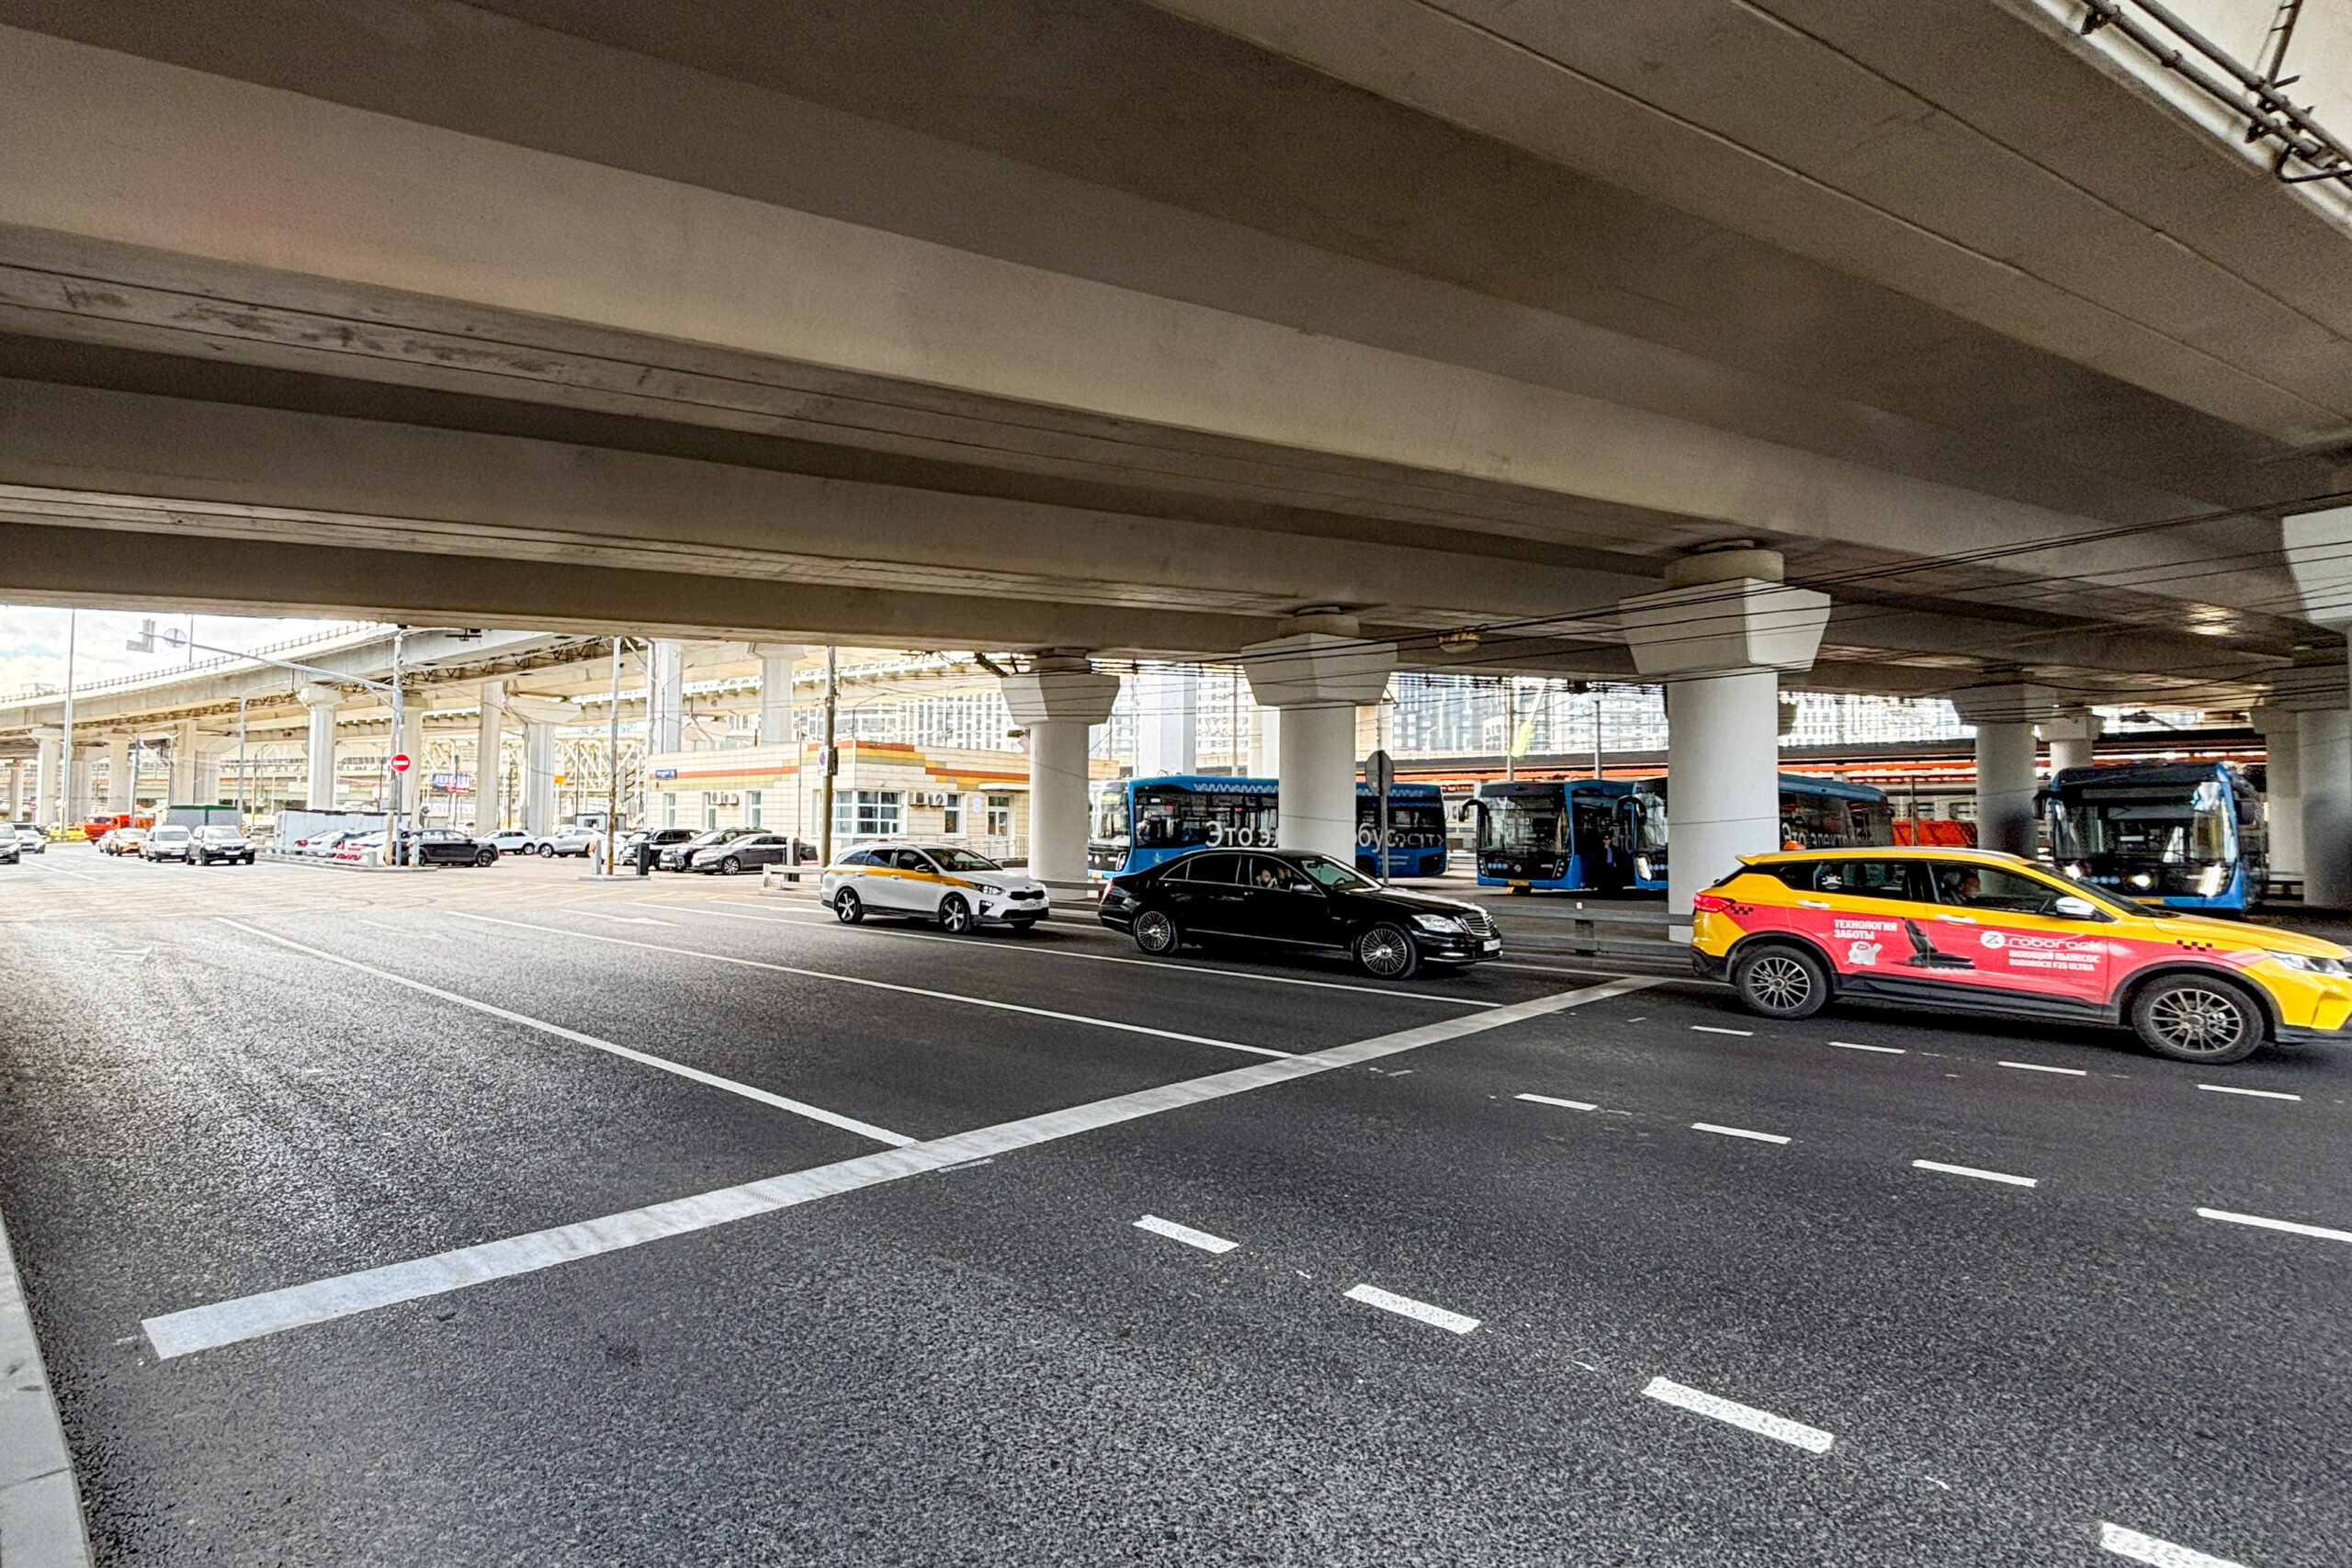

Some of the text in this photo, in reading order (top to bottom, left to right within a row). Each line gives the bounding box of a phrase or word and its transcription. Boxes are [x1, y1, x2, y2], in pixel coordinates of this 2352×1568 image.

[1205, 820, 1252, 847] Это
[1834, 919, 1897, 931] ТЕХНОЛОГИЯ
[1834, 930, 1874, 940] ЗАБОТЫ
[2008, 937, 2102, 951] roborock
